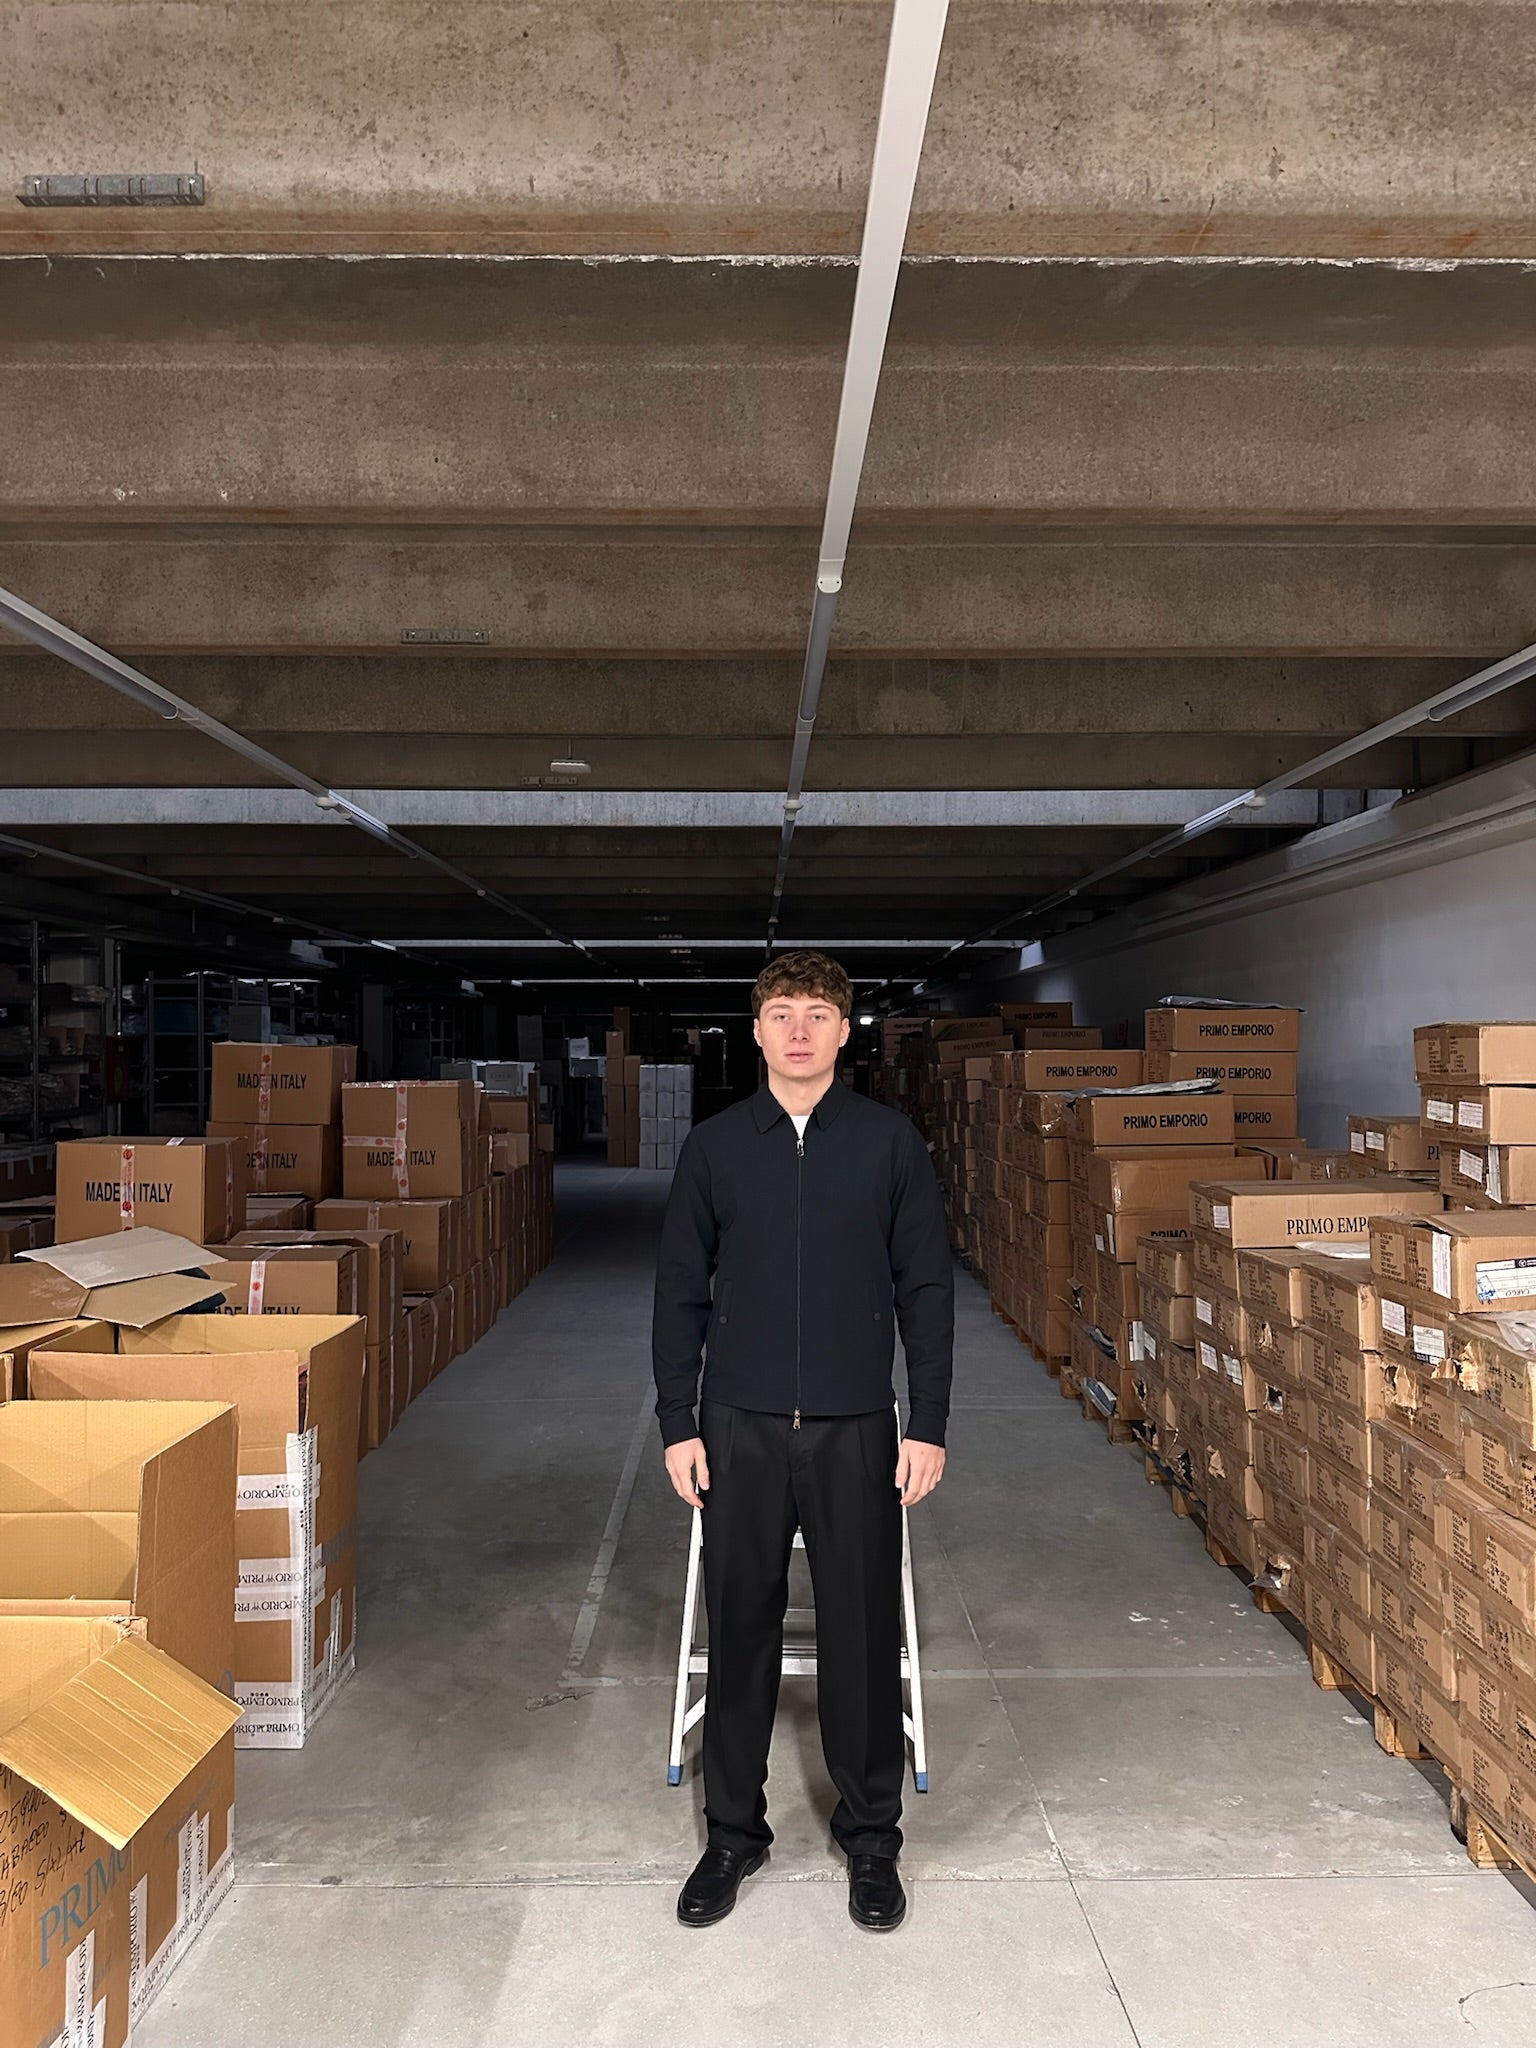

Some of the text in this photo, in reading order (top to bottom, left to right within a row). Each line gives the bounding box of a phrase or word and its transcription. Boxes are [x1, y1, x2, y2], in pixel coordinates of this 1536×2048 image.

[1199, 1024, 1274, 1037] PRIMO EMPORIO
[1046, 1065, 1118, 1078] PRIMO EMPORIO
[1196, 1067, 1272, 1080] PRIMO EMPORIO
[280, 1074, 307, 1089] ITALY
[1123, 1113, 1208, 1129] PRIMO EMPORIO
[1234, 1112, 1272, 1124] MPORIO
[272, 1153, 298, 1168] ITALY
[366, 1150, 436, 1167] MADE ITALY
[86, 1182, 120, 1202] MADE
[140, 1183, 172, 1202] ITALY
[1286, 1216, 1369, 1235] PRIMO EMP
[1505, 1288, 1530, 1297] CARGO
[238, 1572, 302, 1584] PRIM ORIO
[234, 1600, 302, 1612] PRI MPORIO
[235, 1696, 299, 1706] EMPO PRIMO
